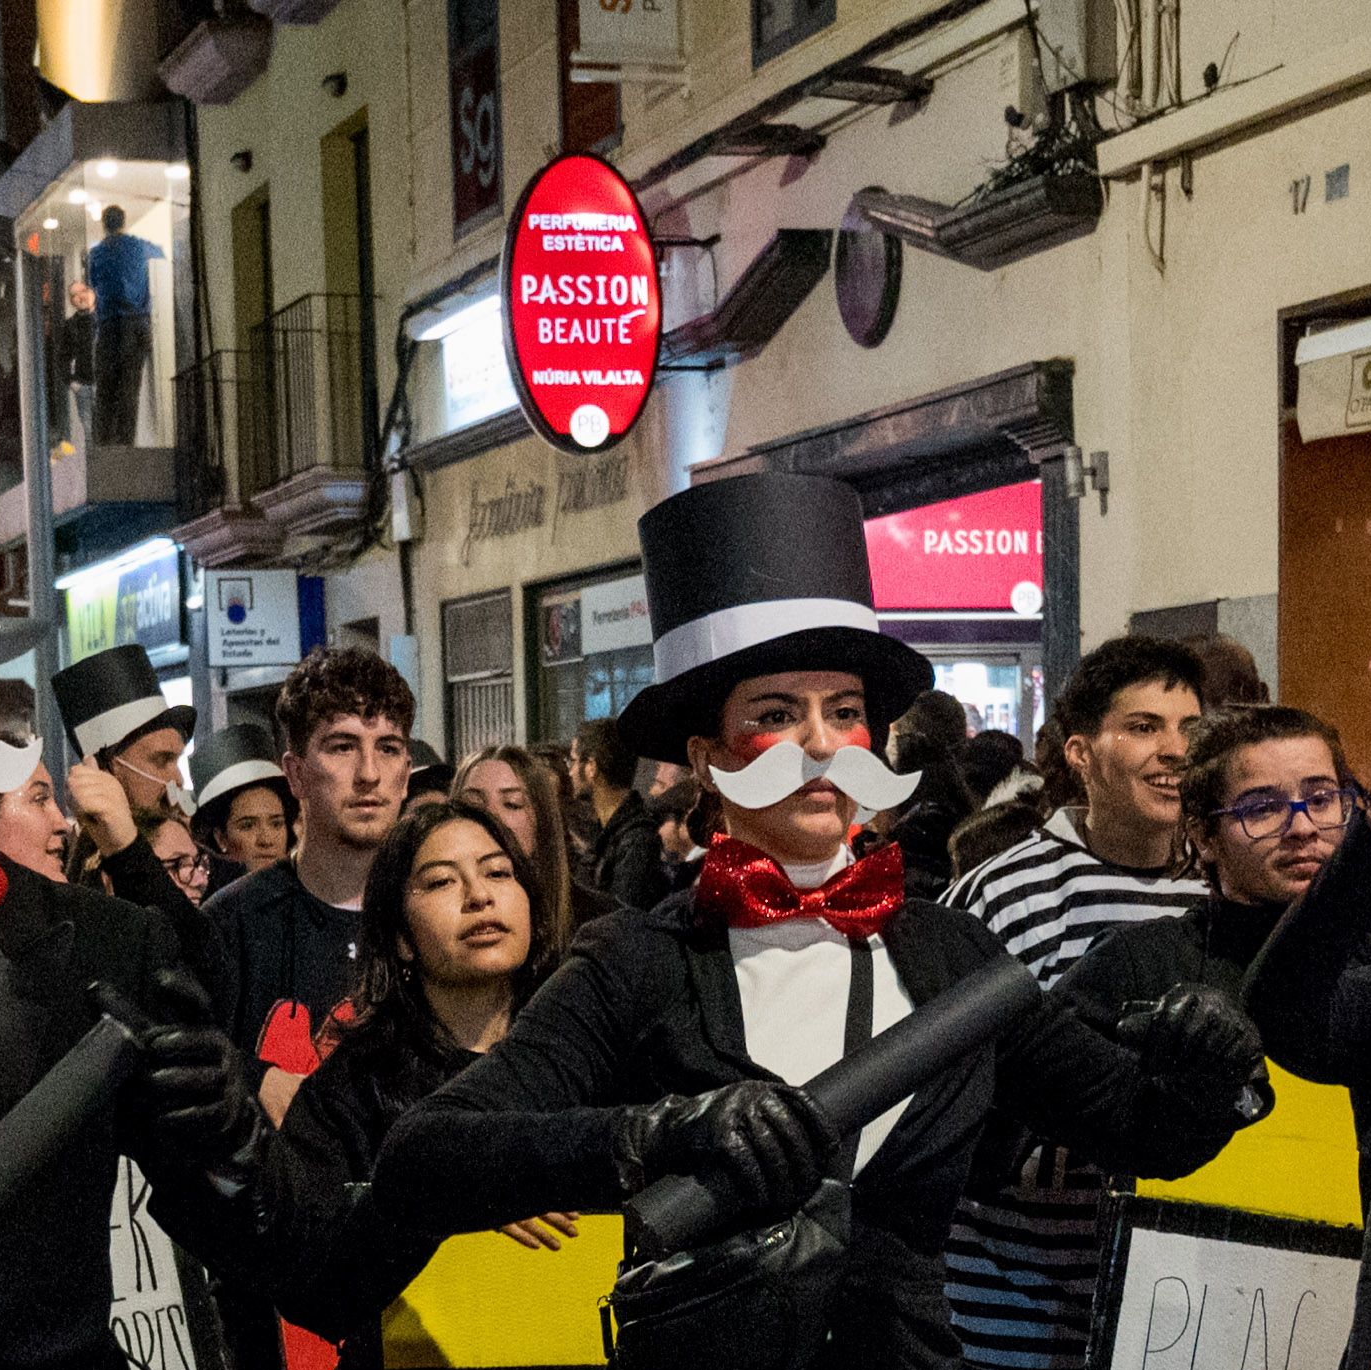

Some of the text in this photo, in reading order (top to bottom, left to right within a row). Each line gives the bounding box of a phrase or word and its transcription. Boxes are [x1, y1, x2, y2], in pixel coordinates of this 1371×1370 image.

[520, 274, 649, 305] PASSION
[537, 309, 647, 344] BEAUTÉ
[532, 368, 644, 386] NÚRIA VILALTA
[924, 529, 1028, 555] PASSION
